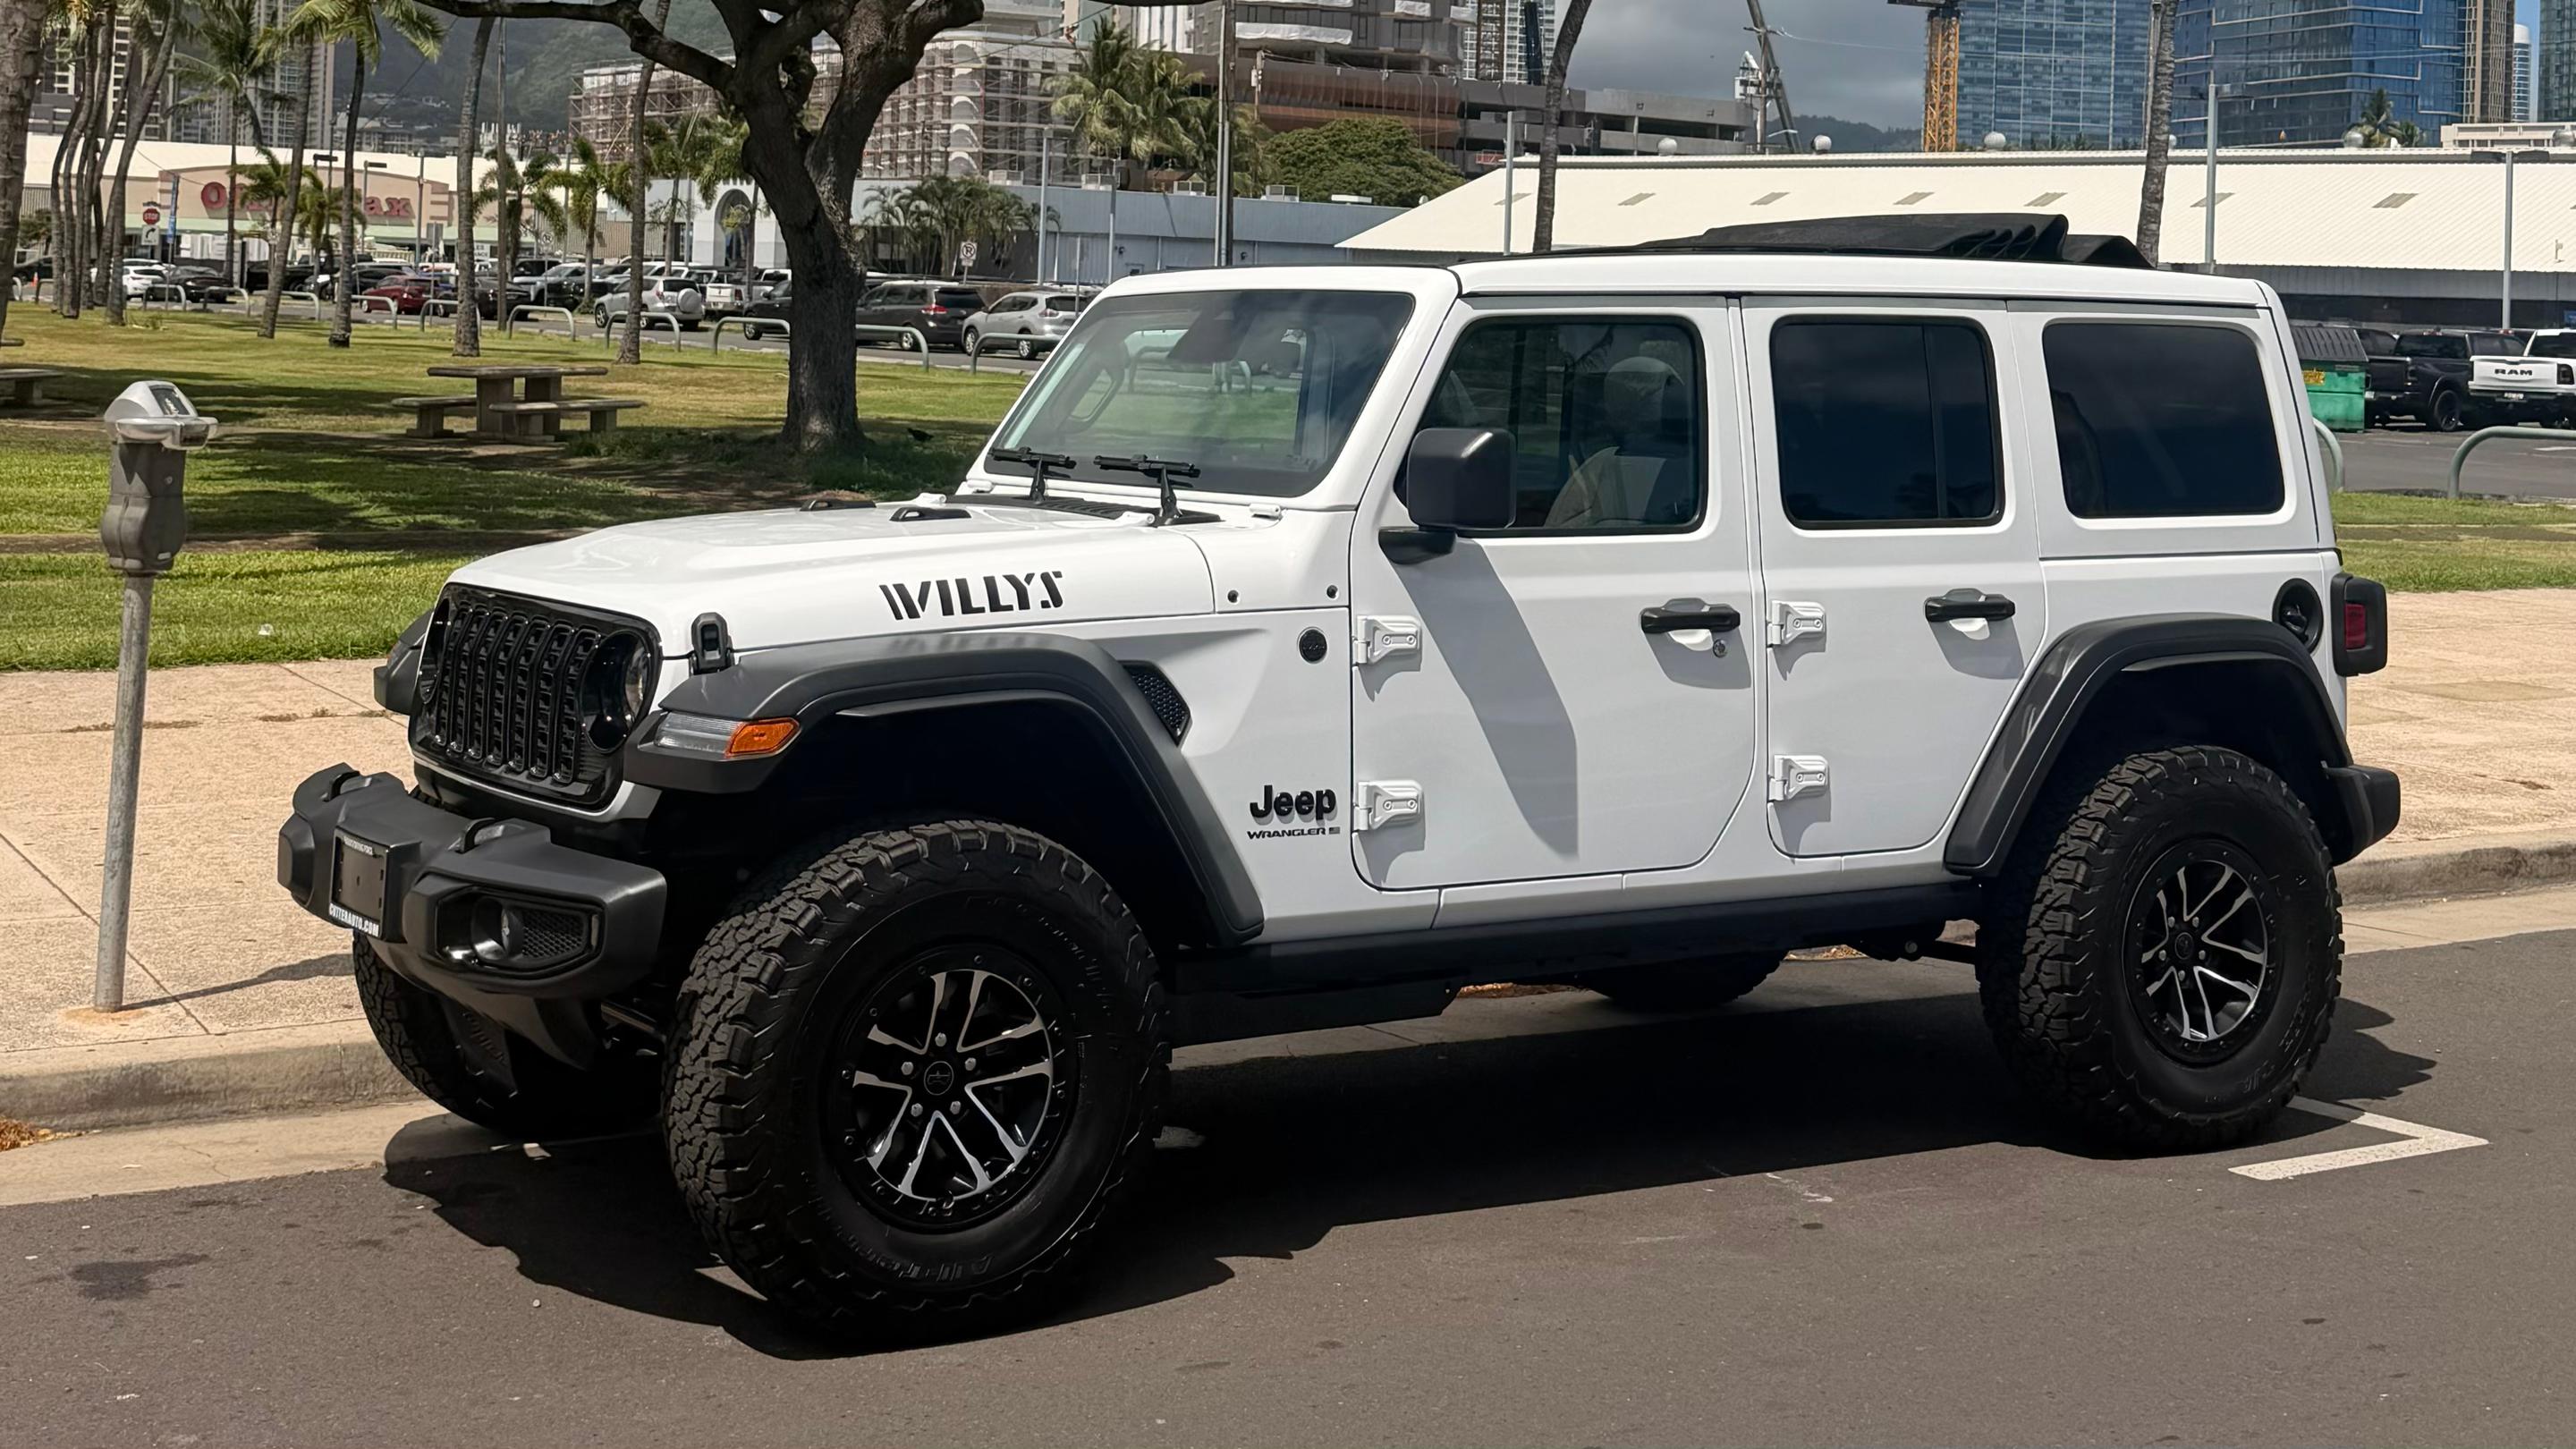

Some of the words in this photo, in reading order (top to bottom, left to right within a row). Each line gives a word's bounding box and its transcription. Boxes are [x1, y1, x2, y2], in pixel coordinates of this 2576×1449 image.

[2494, 368, 2533, 377] RAM
[877, 570, 1063, 620] WILLYS
[1250, 784, 1337, 821] Jeep
[1247, 827, 1326, 840] WRANGLER
[328, 902, 380, 937] CUTTERAUTO.COM
